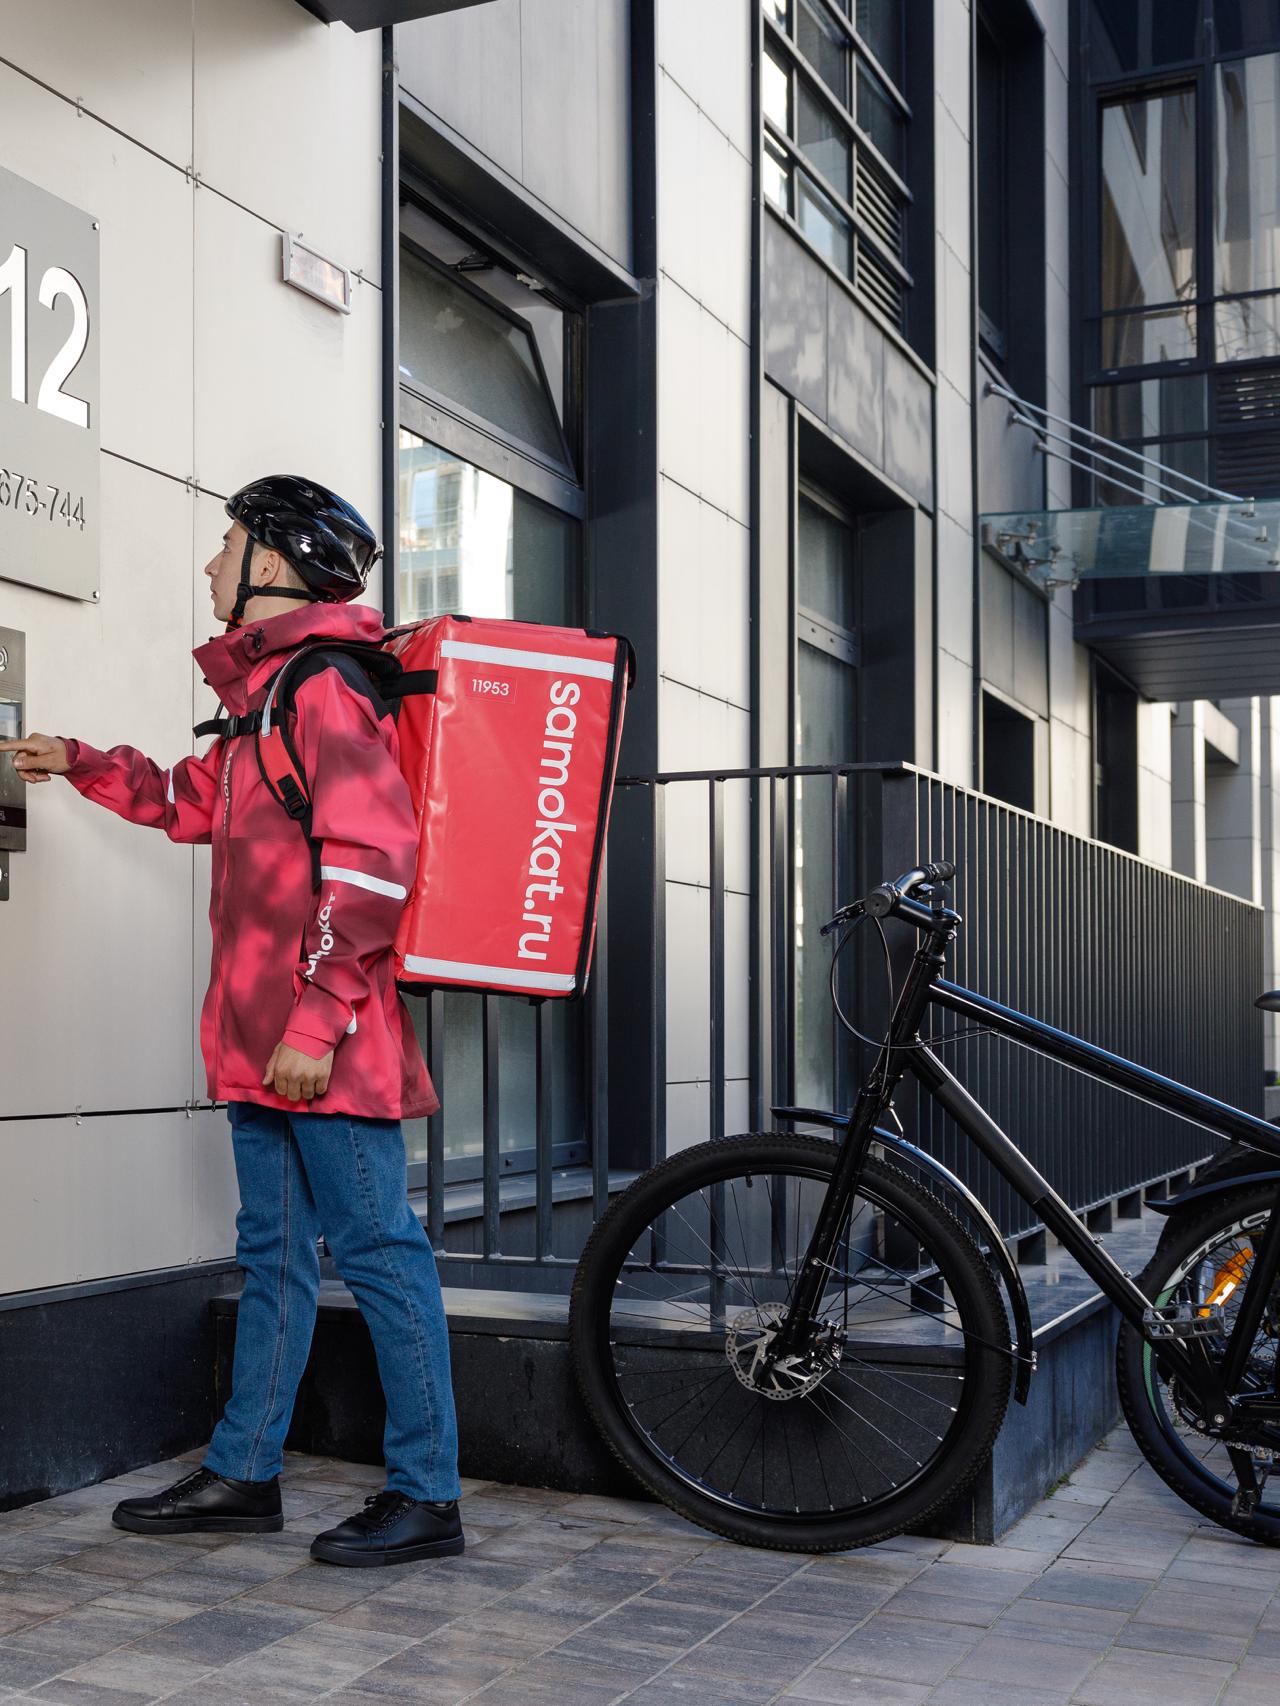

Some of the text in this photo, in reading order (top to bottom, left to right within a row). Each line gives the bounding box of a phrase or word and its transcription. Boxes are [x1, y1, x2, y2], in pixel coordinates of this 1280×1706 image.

[470, 678, 510, 697] 11953
[517, 680, 581, 961] samokat.ru
[303, 891, 336, 983] амокат
